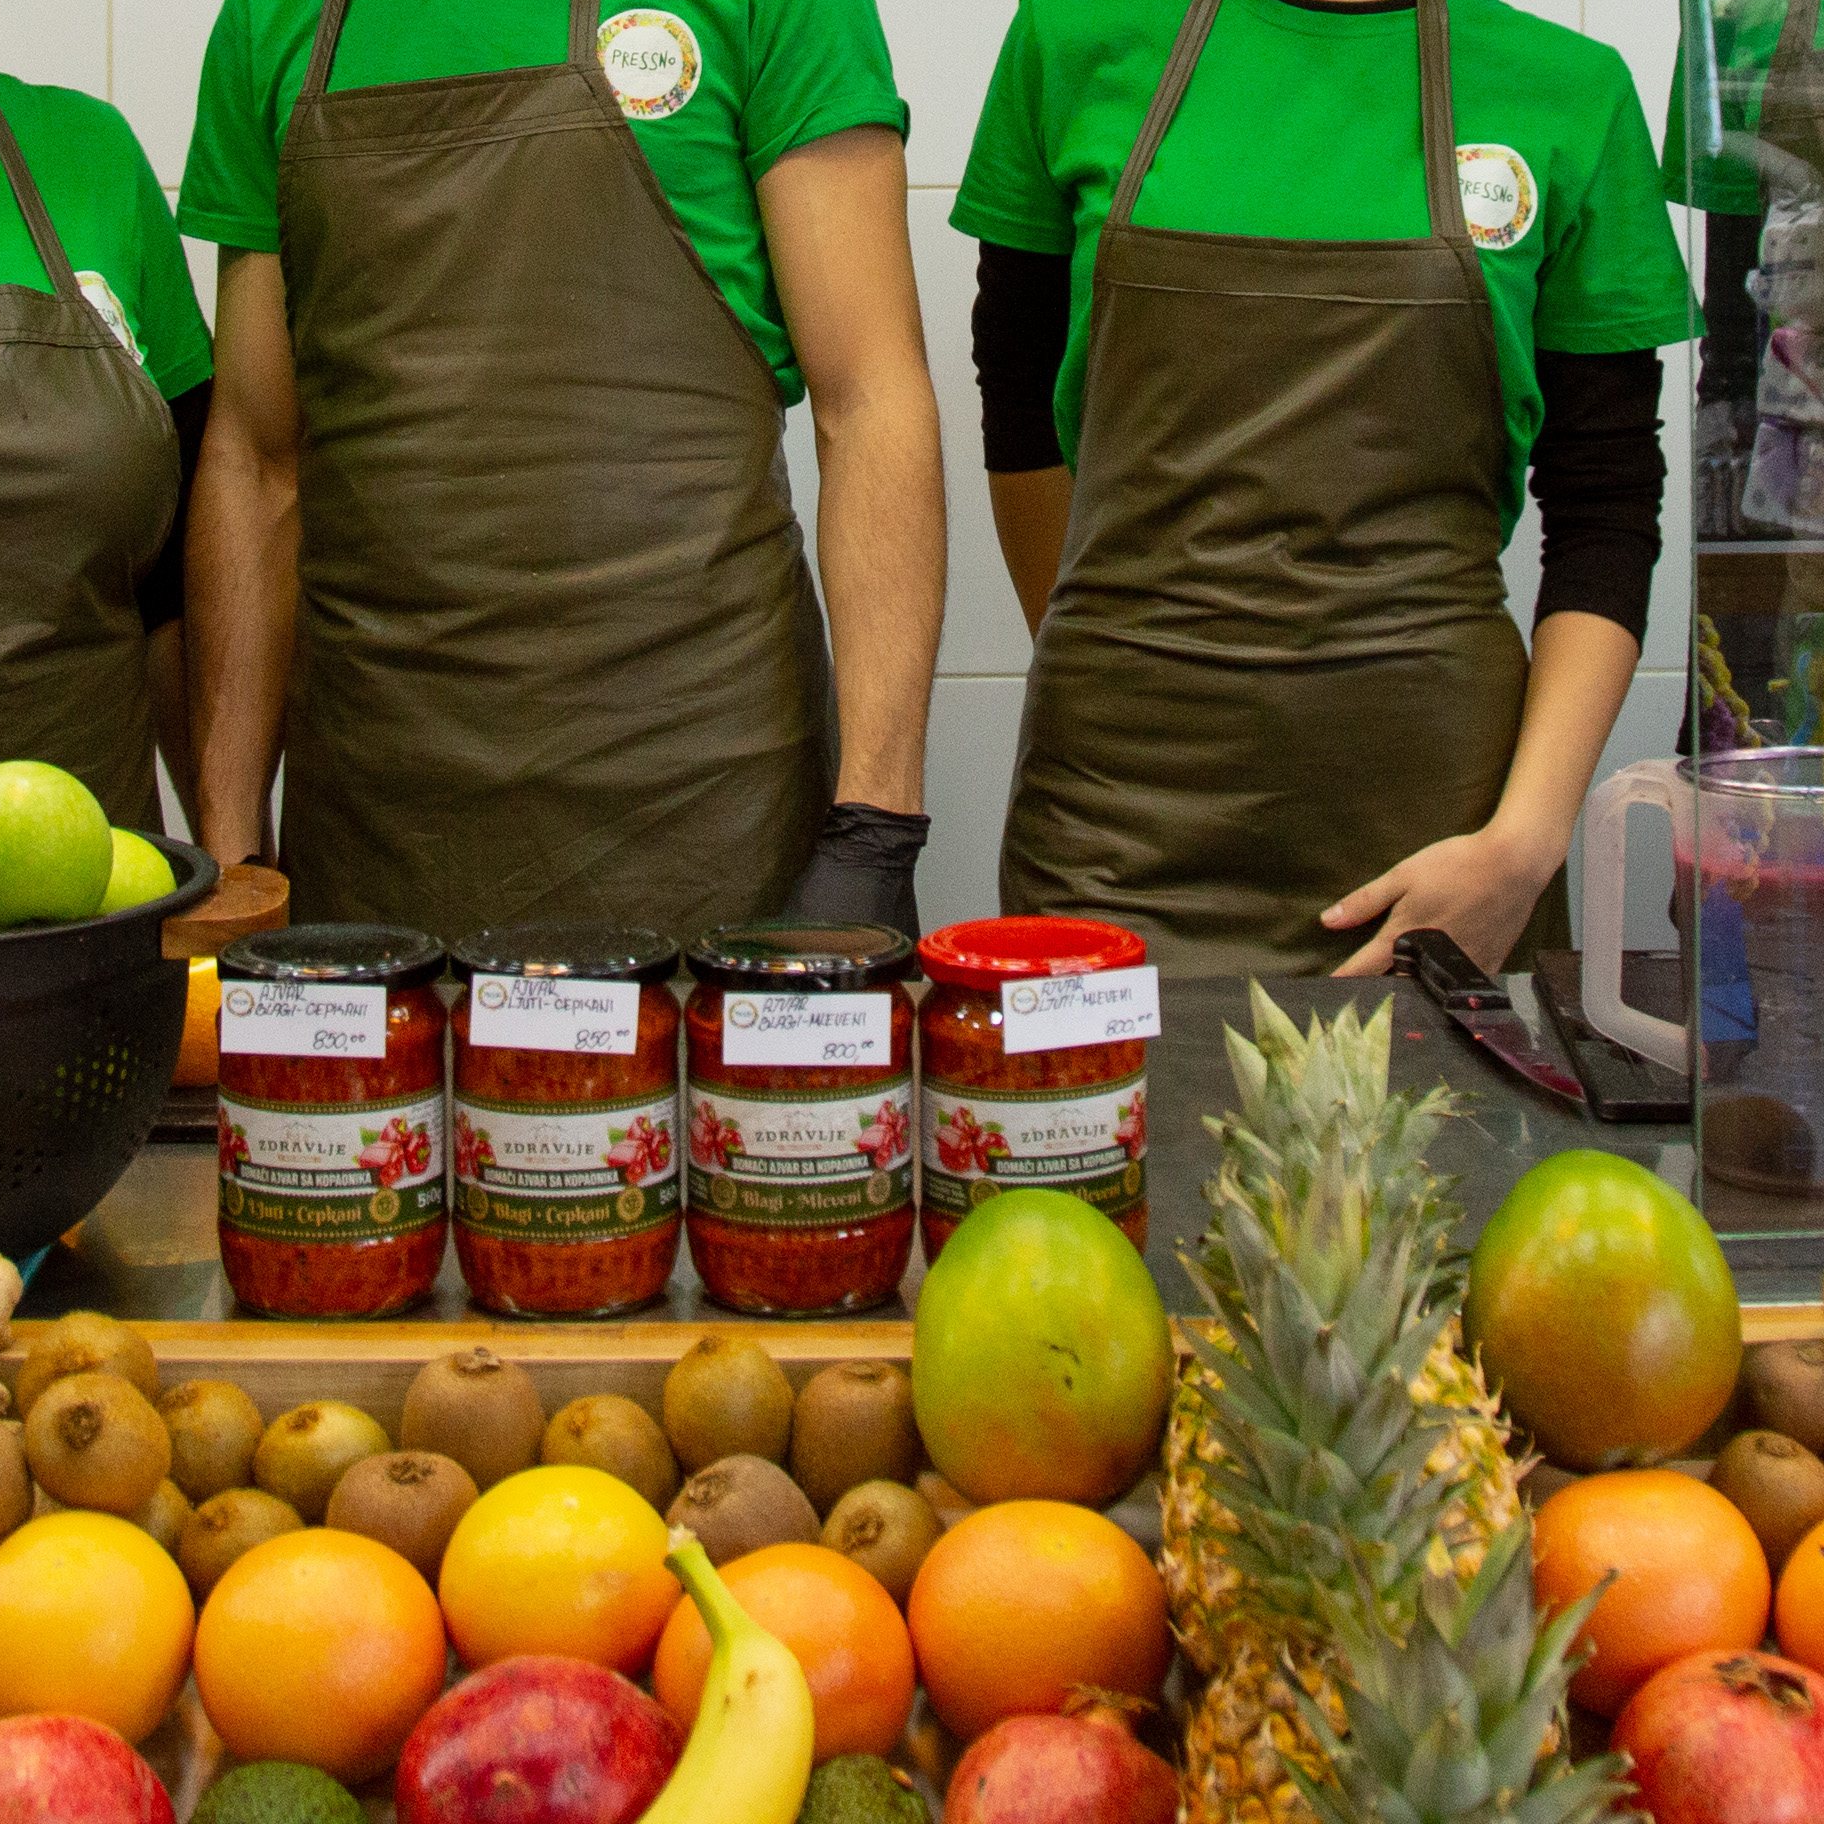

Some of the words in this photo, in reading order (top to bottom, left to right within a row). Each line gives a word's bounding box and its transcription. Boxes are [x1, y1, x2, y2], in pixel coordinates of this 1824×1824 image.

[754, 1129, 847, 1143] ZDRAVLJE
[1020, 1124, 1109, 1145] ZDRAVLJE
[257, 1139, 347, 1156] ZDRAVLJE
[503, 1141, 595, 1156] ZDRAVLJE
